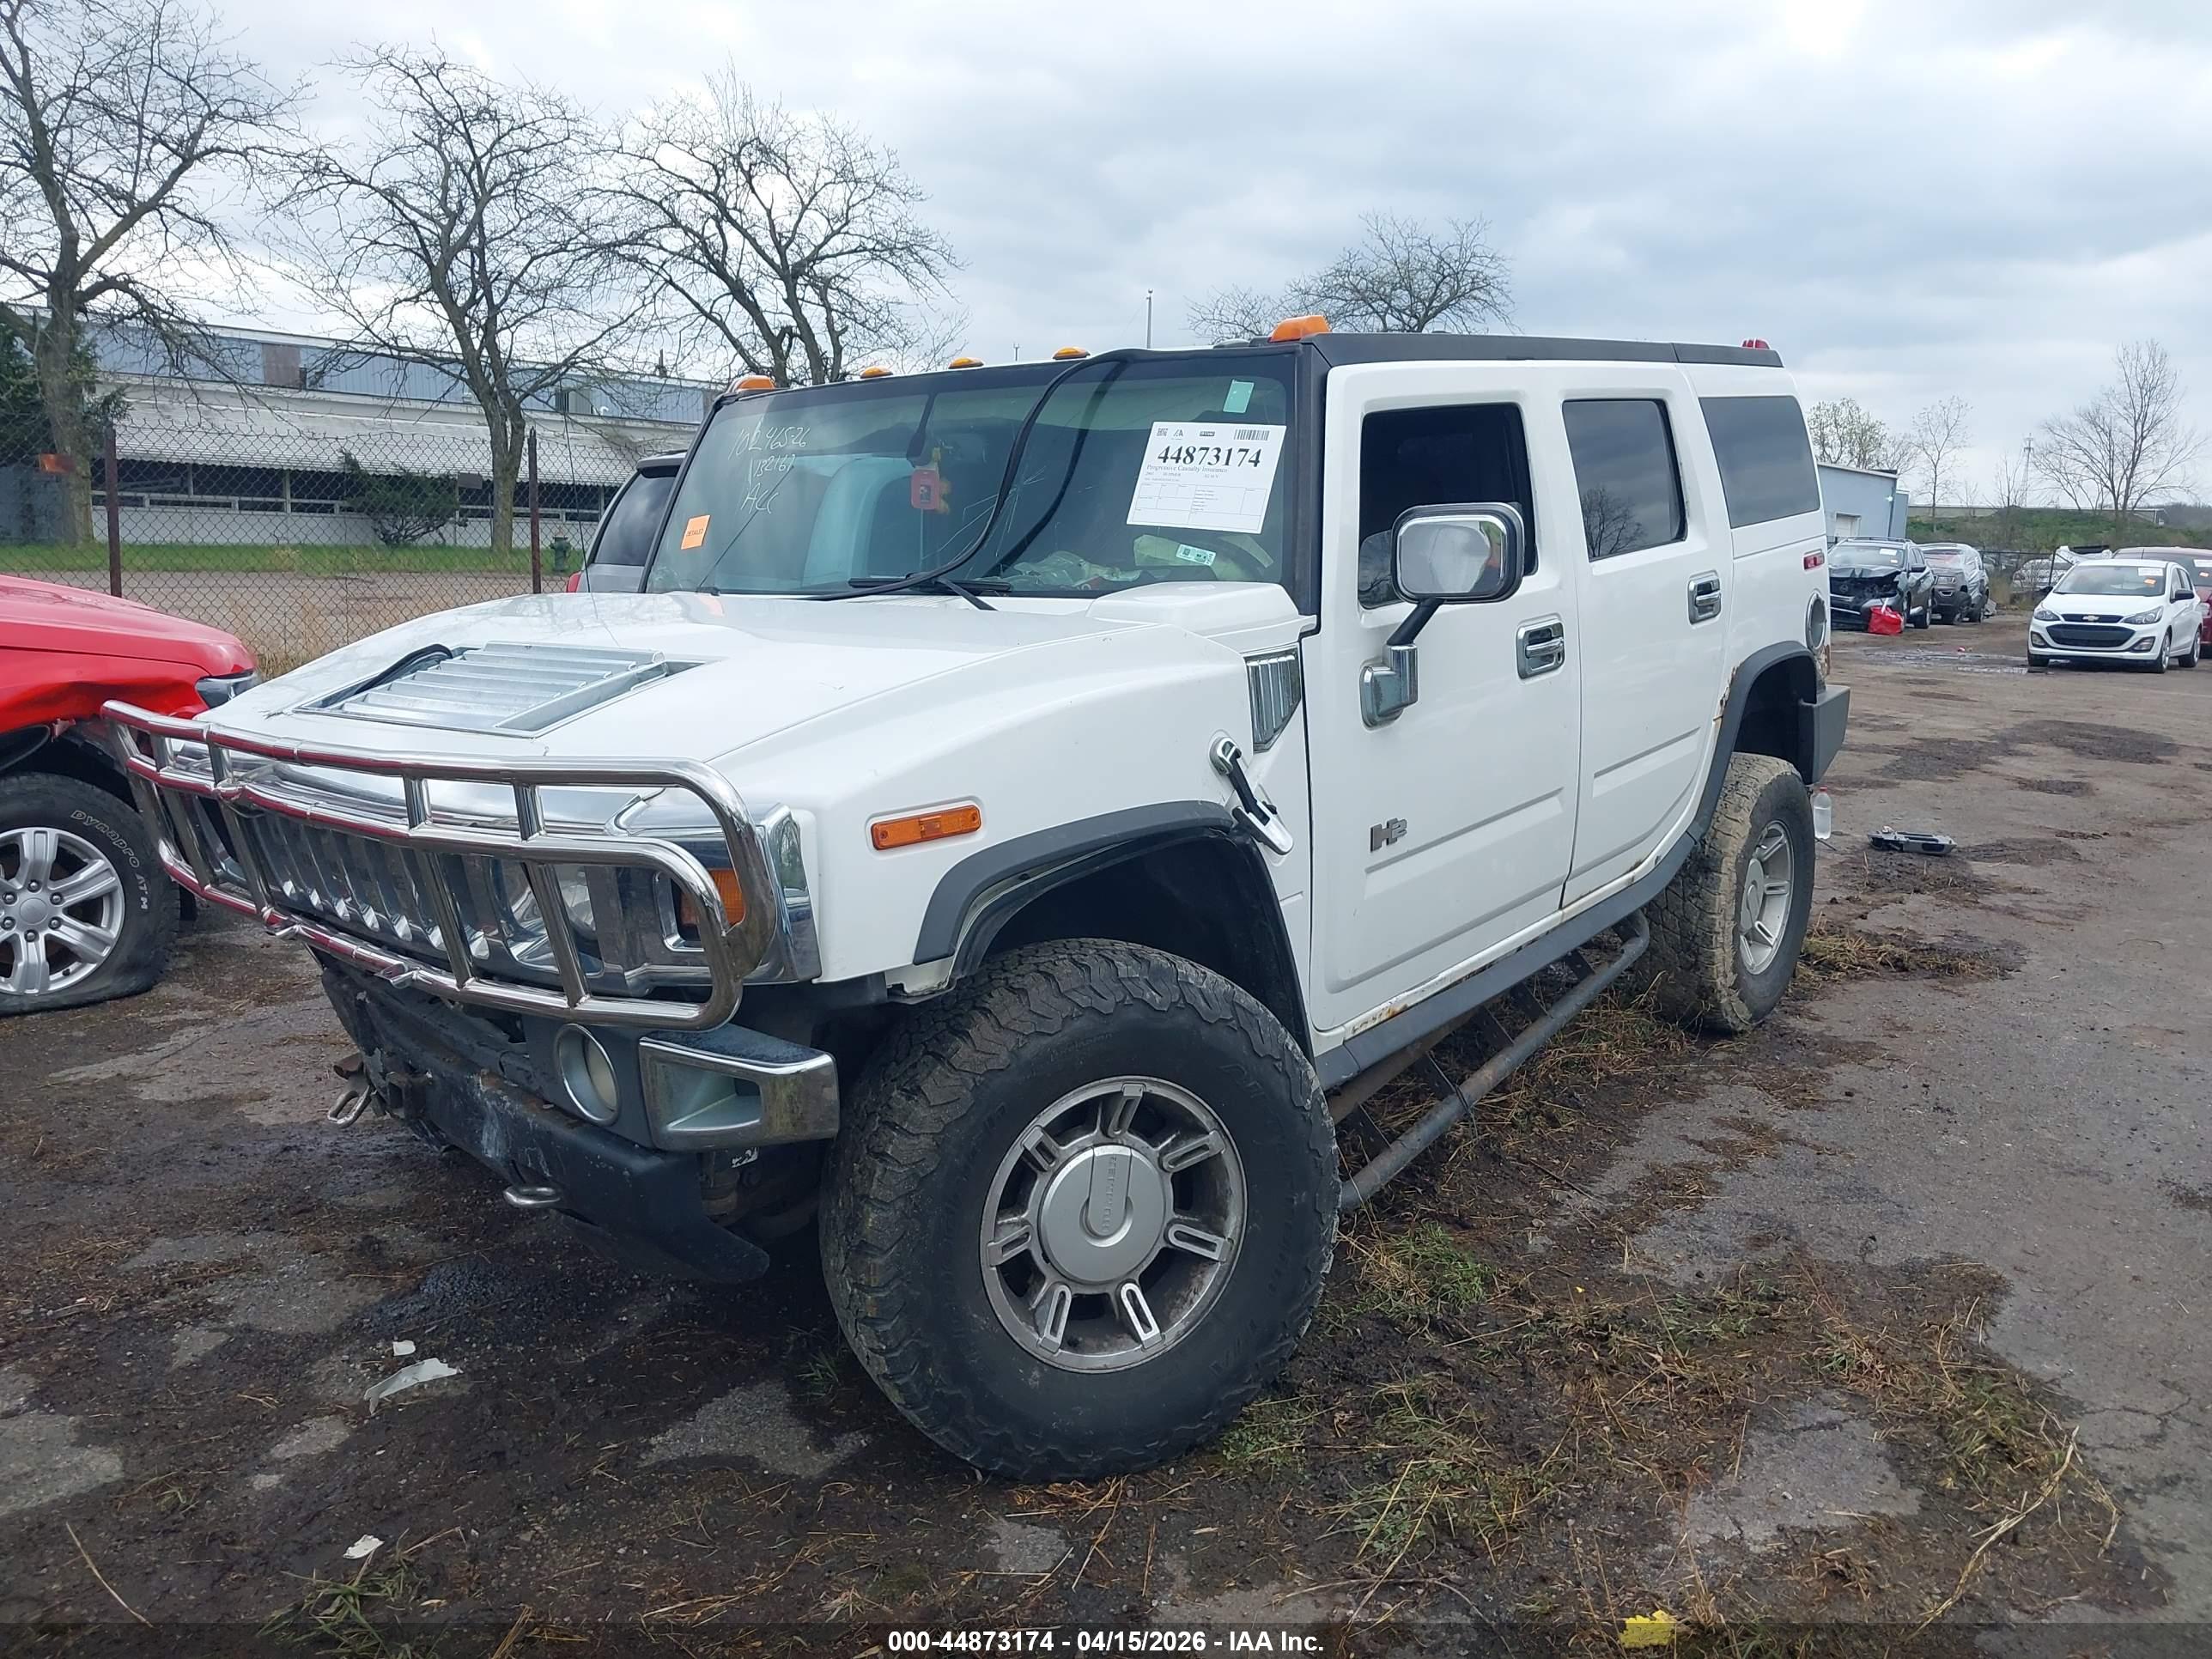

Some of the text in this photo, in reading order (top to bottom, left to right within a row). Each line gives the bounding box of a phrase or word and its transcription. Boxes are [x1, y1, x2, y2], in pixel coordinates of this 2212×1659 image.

[1157, 445, 1262, 468] 44873174
[70, 810, 140, 868] Dynapro
[1370, 817, 1408, 853] H2
